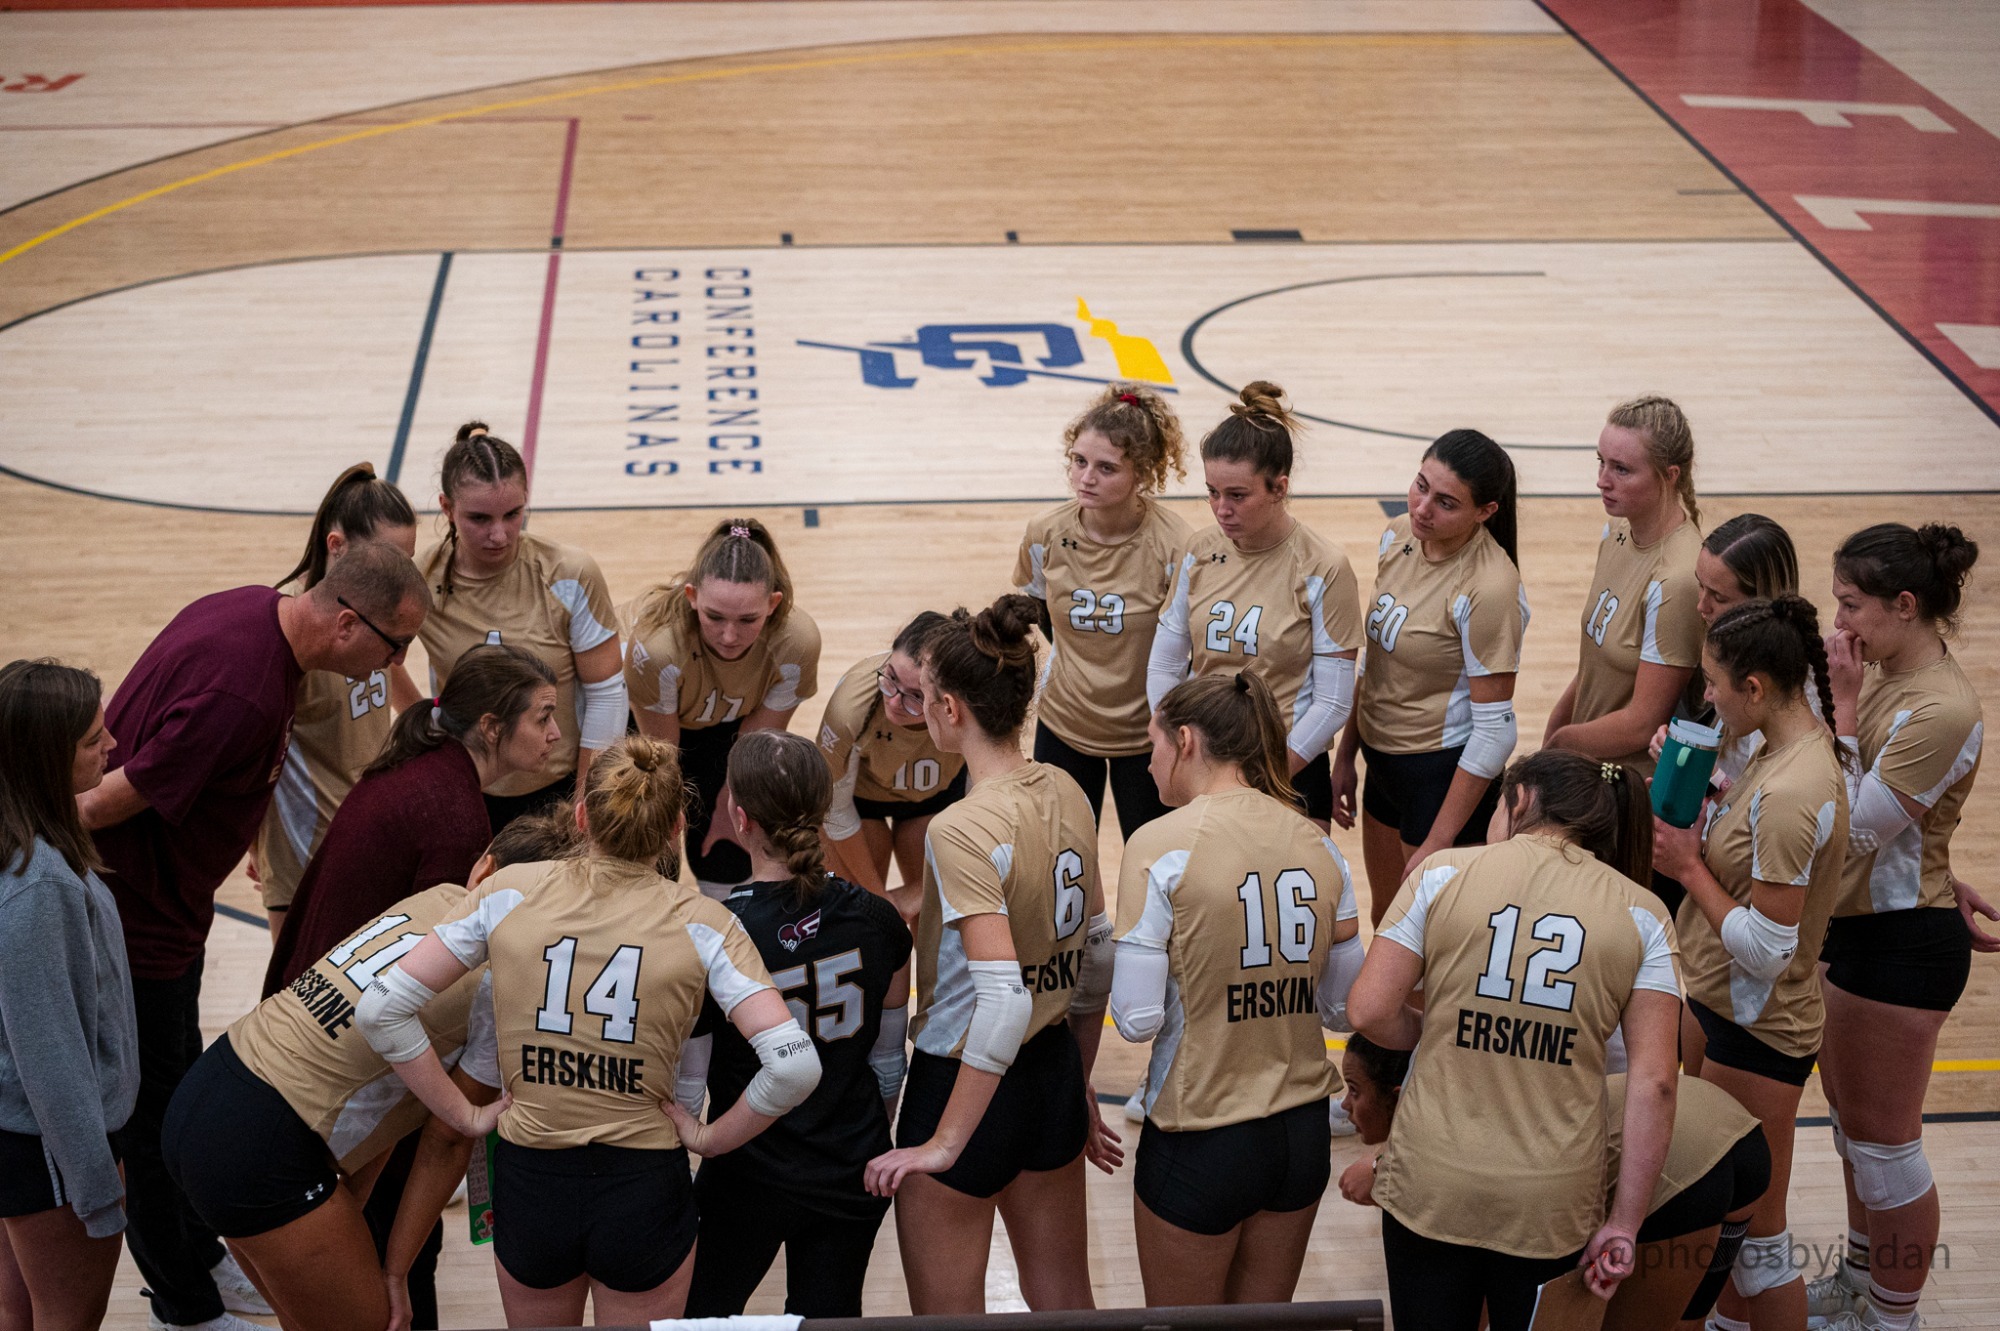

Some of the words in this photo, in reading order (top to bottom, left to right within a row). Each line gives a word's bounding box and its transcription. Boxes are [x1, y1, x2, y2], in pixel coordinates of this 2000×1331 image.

[624, 268, 680, 477] CAROLINAS
[704, 268, 763, 475] CONFERENCE
[1068, 588, 1126, 635] 23
[1205, 600, 1264, 657] 24
[1365, 592, 1409, 654] 20
[1586, 588, 1620, 648] 13
[345, 670, 387, 720] 25
[694, 688, 744, 723] 17
[892, 757, 941, 793] 10
[1053, 847, 1086, 942] 6
[1237, 866, 1318, 969] 16
[326, 913, 427, 993] 11
[1473, 902, 1587, 1013] 12
[534, 935, 643, 1045] 14
[770, 947, 864, 1043] 55
[1227, 975, 1319, 1023] ERSKIN
[1455, 1008, 1578, 1067] ERSKINE
[521, 1044, 644, 1095] ERSKINE
